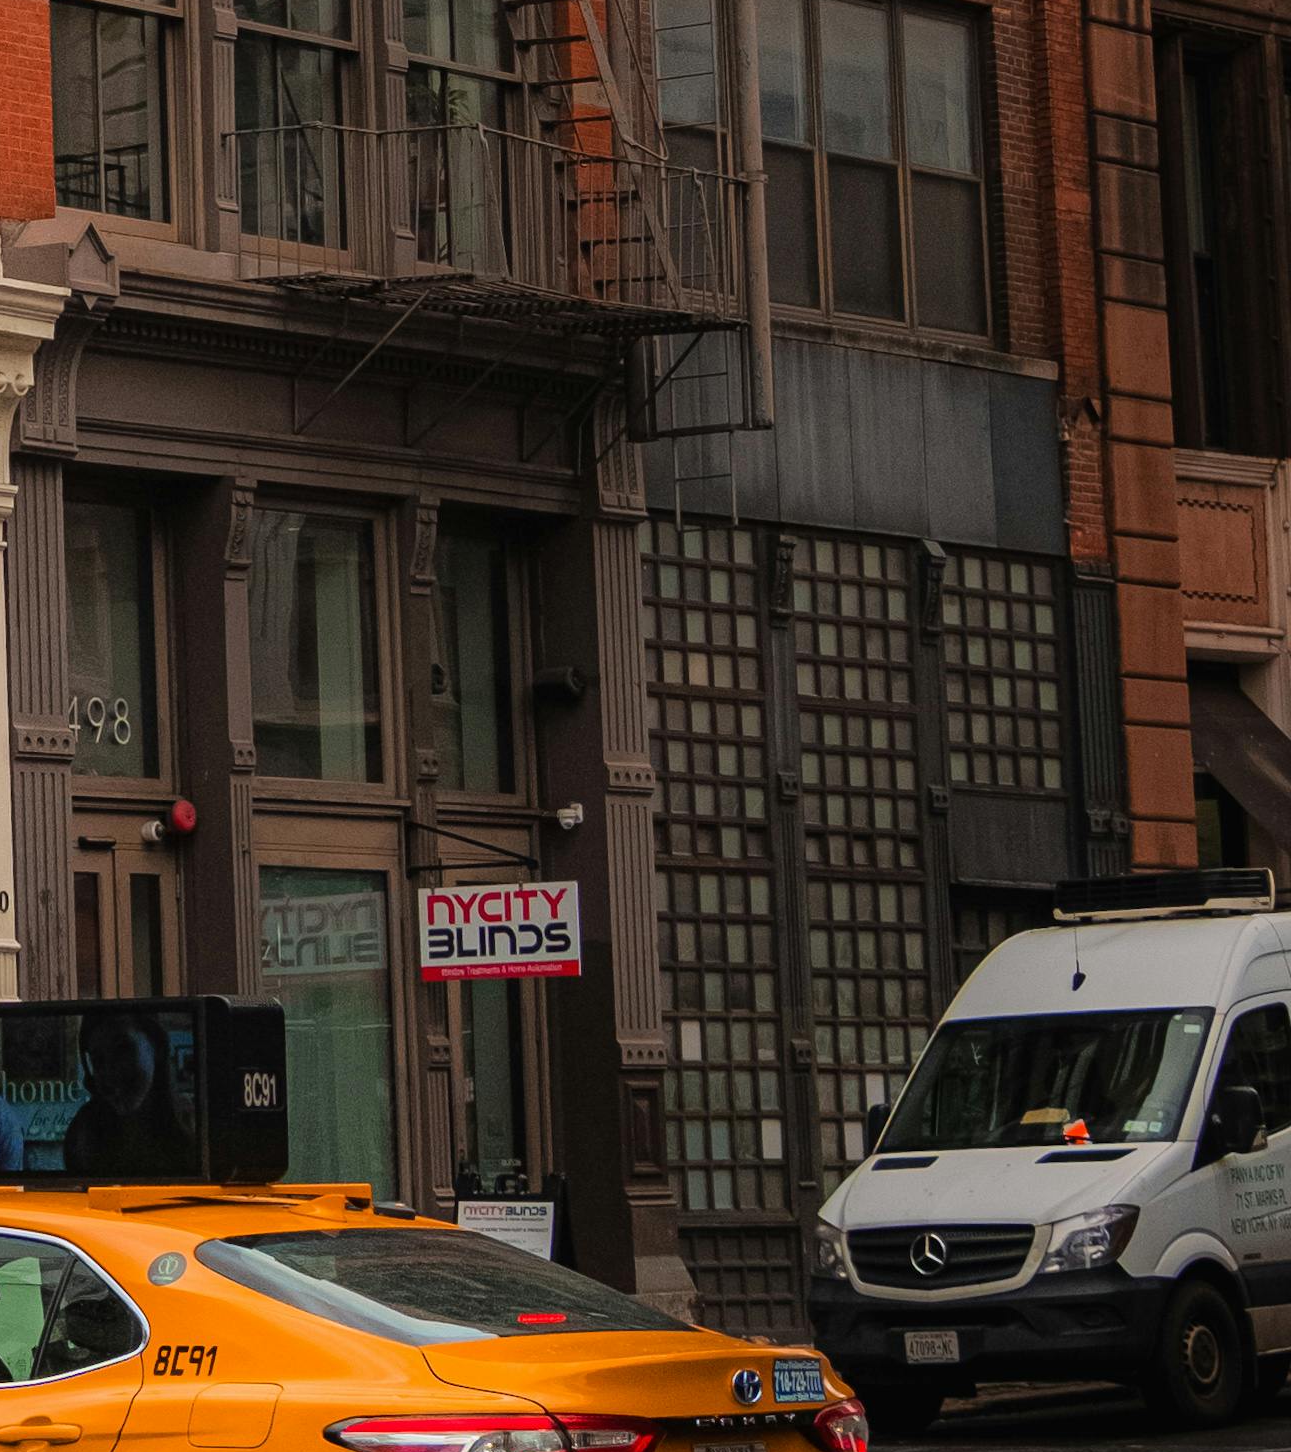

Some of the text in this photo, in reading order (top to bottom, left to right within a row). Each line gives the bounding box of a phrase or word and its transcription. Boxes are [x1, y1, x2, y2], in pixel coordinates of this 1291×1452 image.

[427, 888, 567, 925] NYCITY
[428, 922, 571, 959] BLINDS
[244, 1072, 277, 1107] 8C91
[153, 1345, 218, 1377] 8C91
